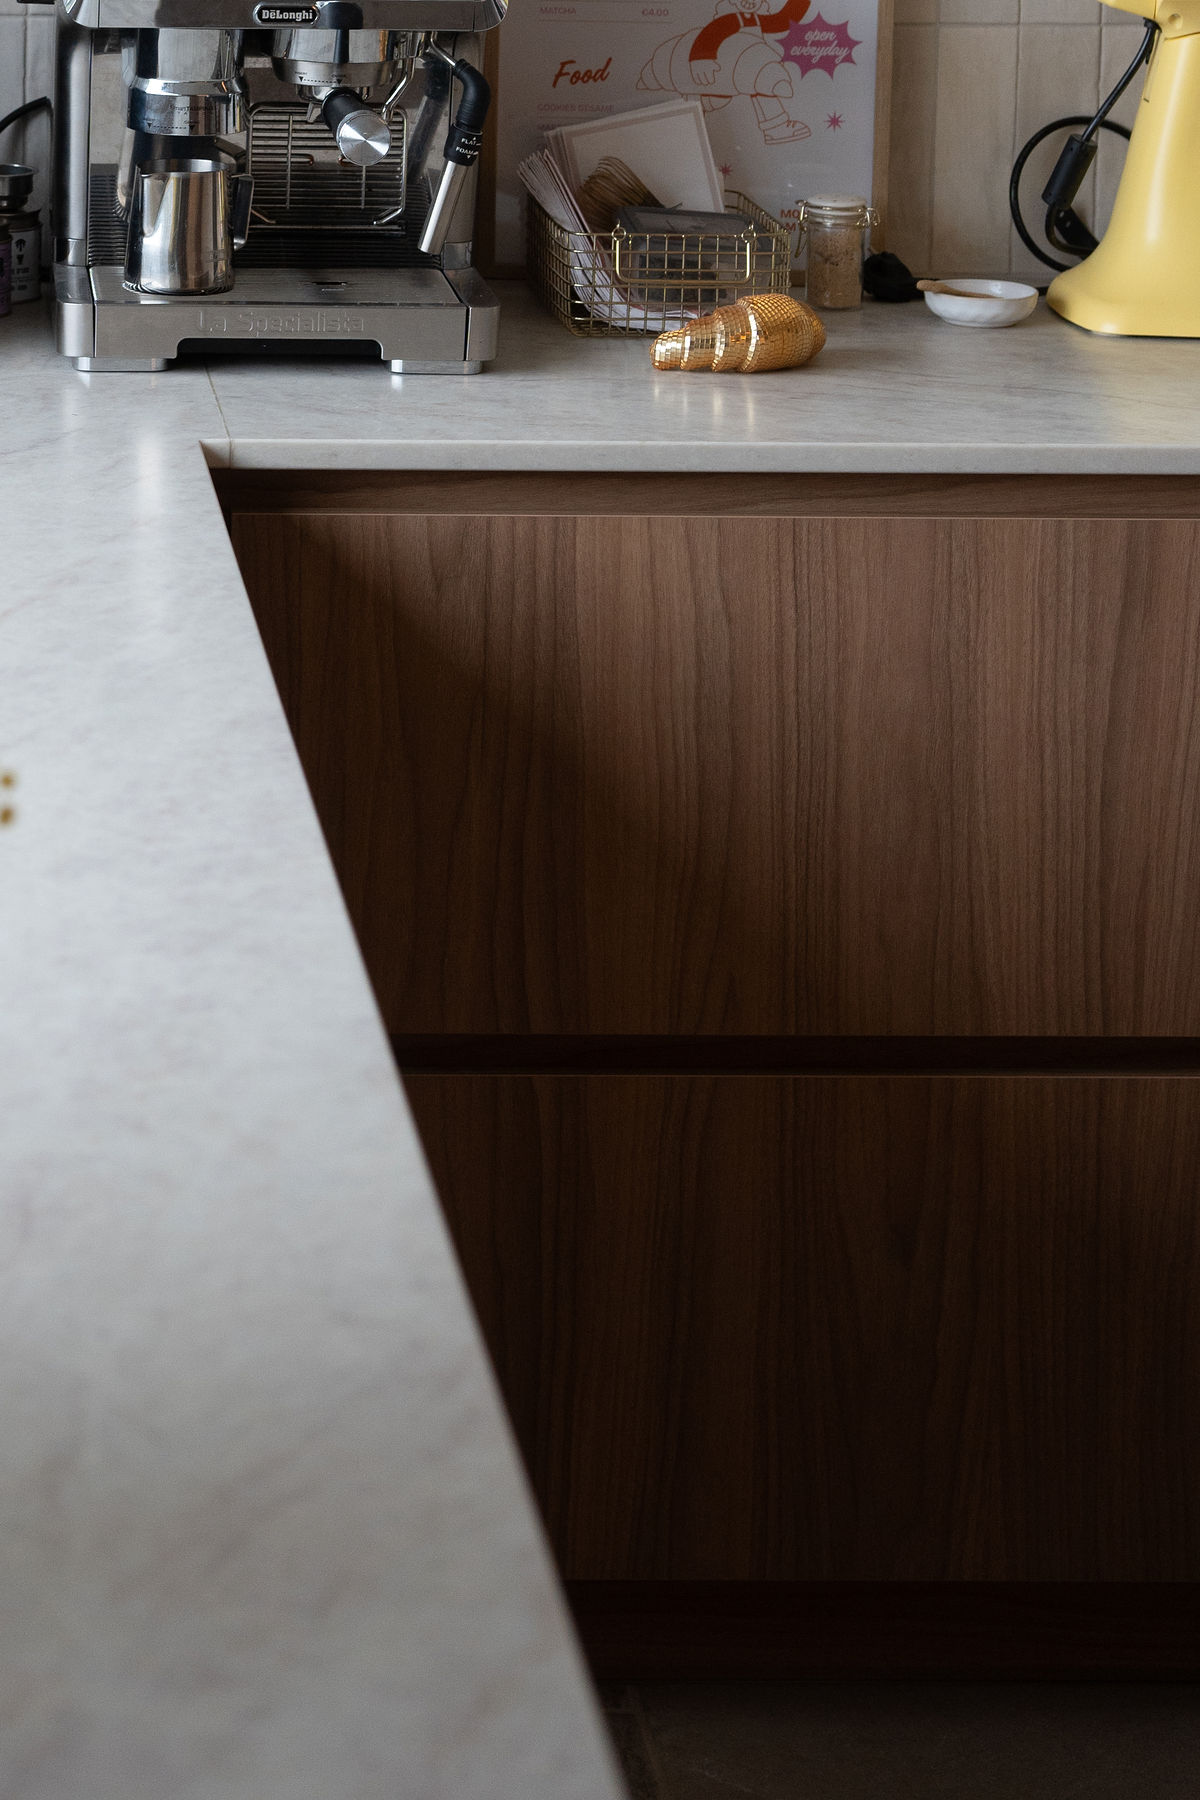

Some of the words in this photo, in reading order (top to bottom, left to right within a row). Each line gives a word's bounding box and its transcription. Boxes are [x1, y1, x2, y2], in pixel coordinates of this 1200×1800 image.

[539, 6, 577, 14] MATCHA
[641, 8, 669, 16] €4.00
[804, 30, 837, 46] open
[790, 40, 850, 64] everyday
[552, 57, 613, 89] Food
[461, 137, 477, 145] FLAT
[455, 146, 474, 155] FOAM
[198, 310, 227, 332] La
[238, 309, 364, 338] Specialista
